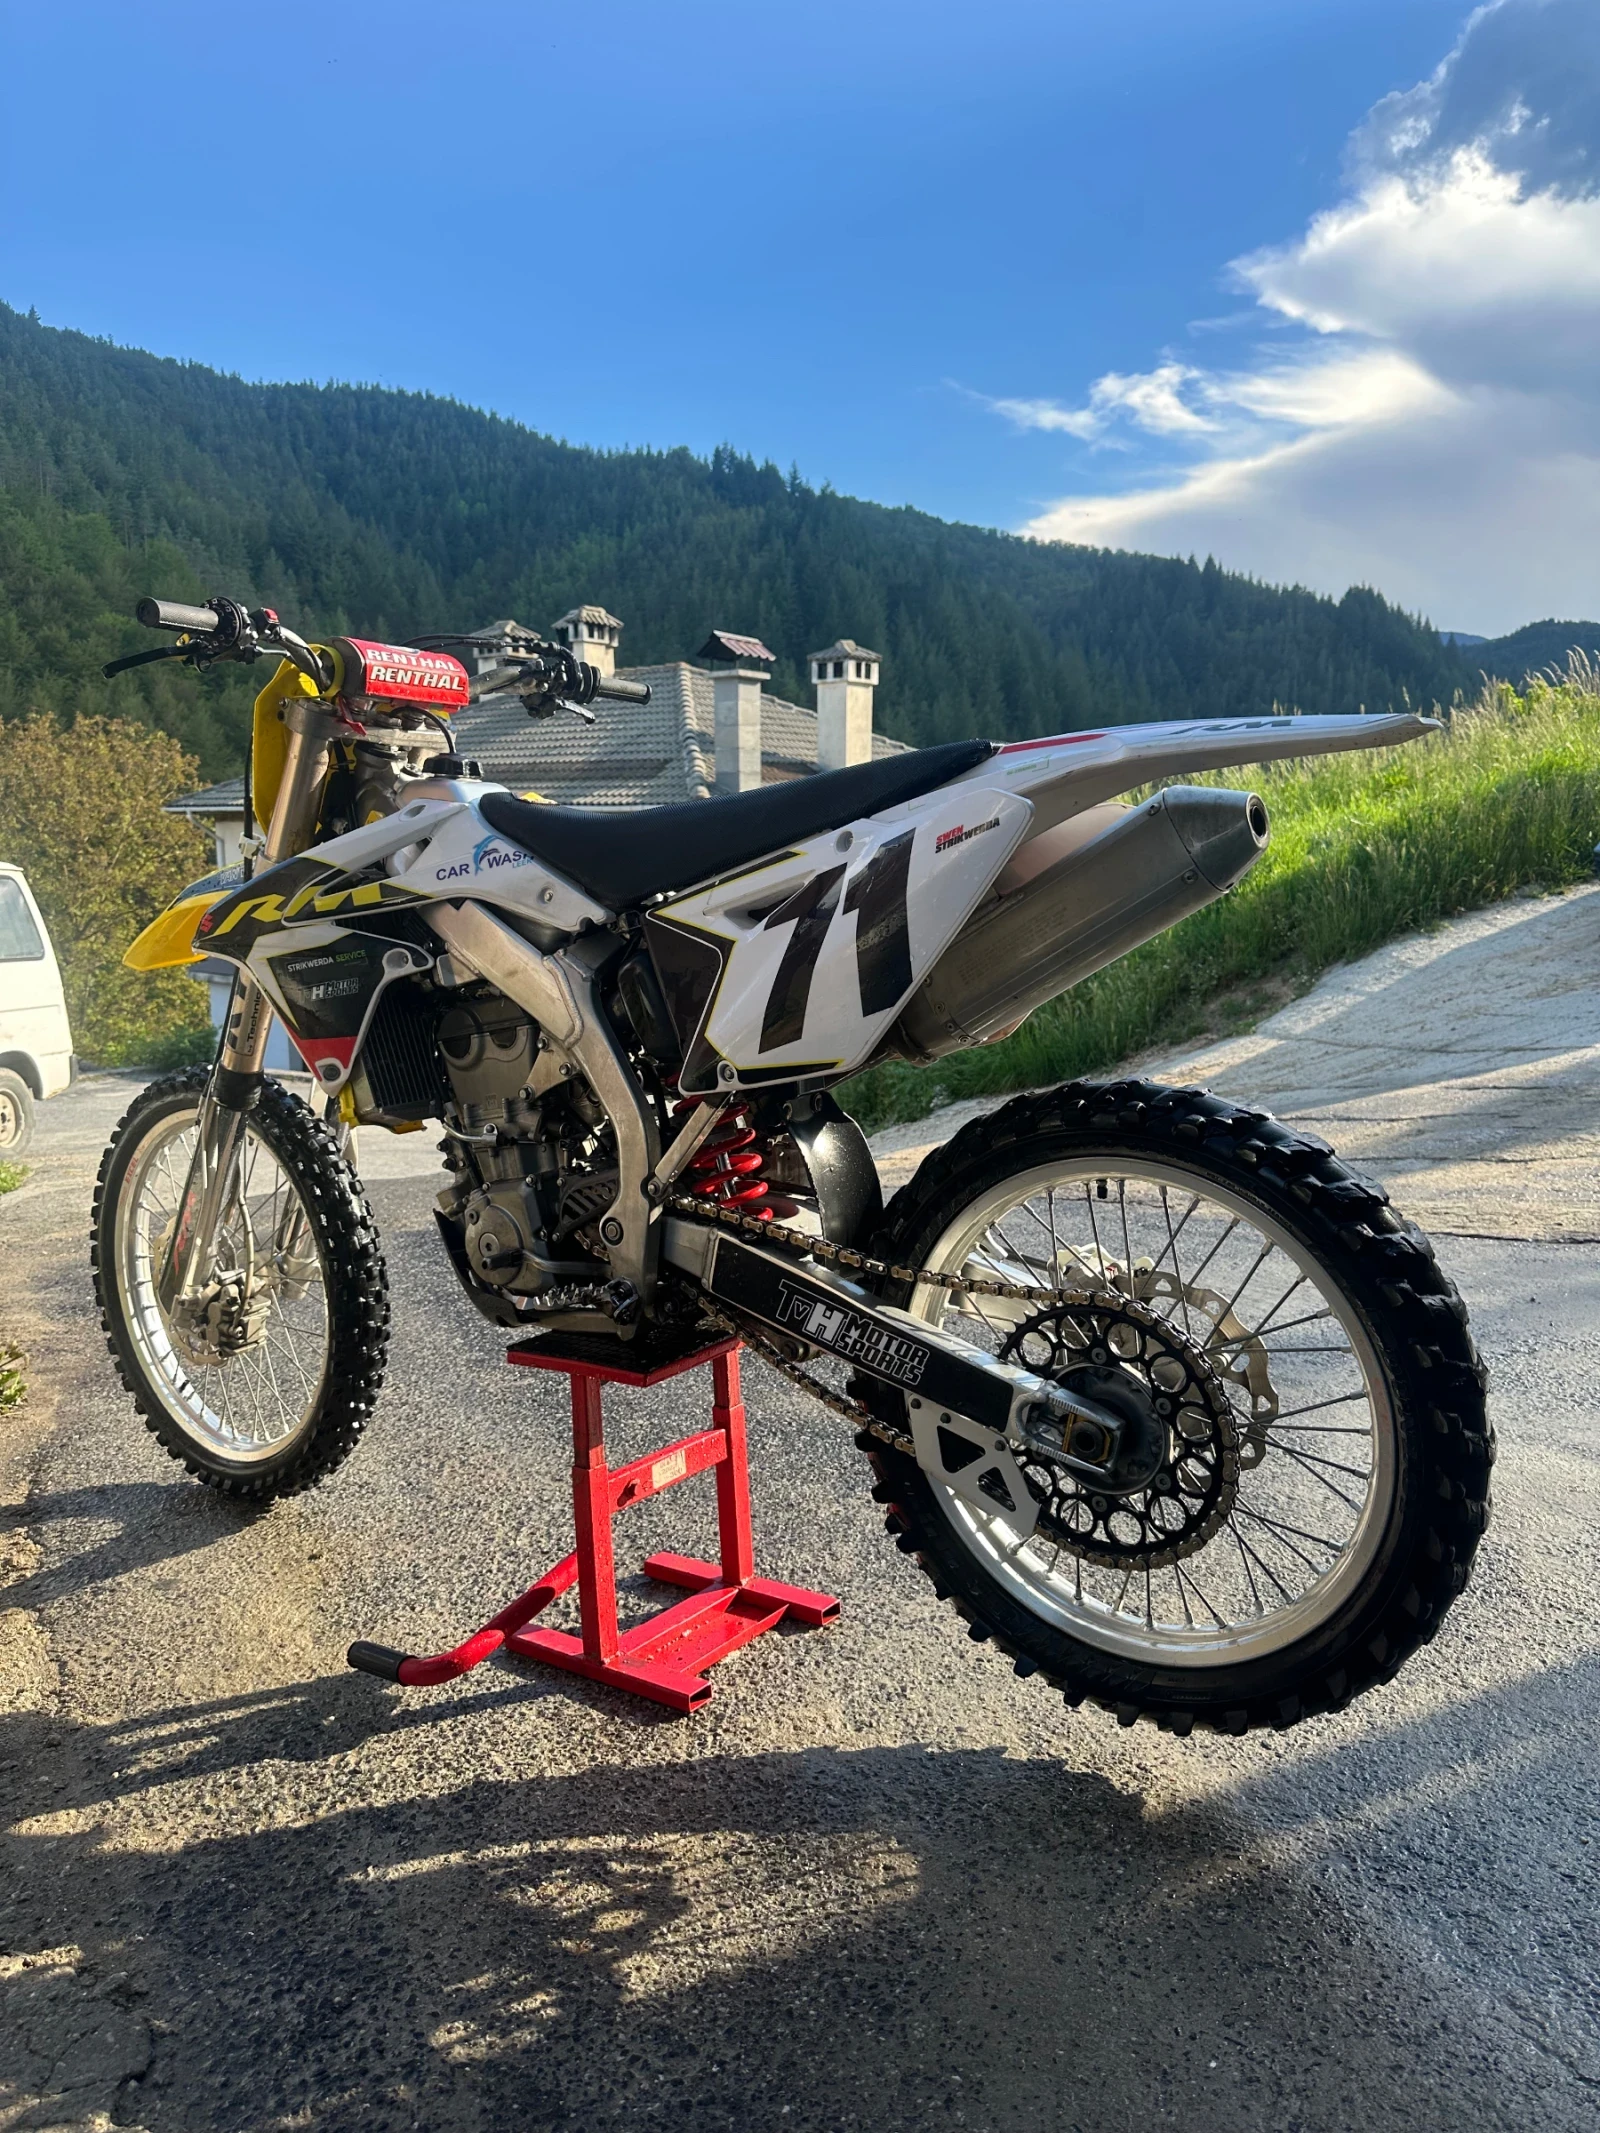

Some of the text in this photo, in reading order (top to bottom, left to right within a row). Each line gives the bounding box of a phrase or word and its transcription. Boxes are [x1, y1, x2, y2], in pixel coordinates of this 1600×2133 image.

[366, 649, 461, 672] RENTHAL
[370, 665, 464, 691] RENTHAL
[936, 824, 964, 846] SWEN
[436, 863, 471, 881] CAR
[212, 883, 382, 937] RM
[287, 956, 334, 972] STRIKWERDA
[335, 949, 366, 962] SERVICE
[325, 977, 359, 992] MOTOR
[325, 986, 359, 999] SPORTS
[844, 1312, 930, 1368] MOTOR
[835, 1330, 926, 1386] SPORTS
